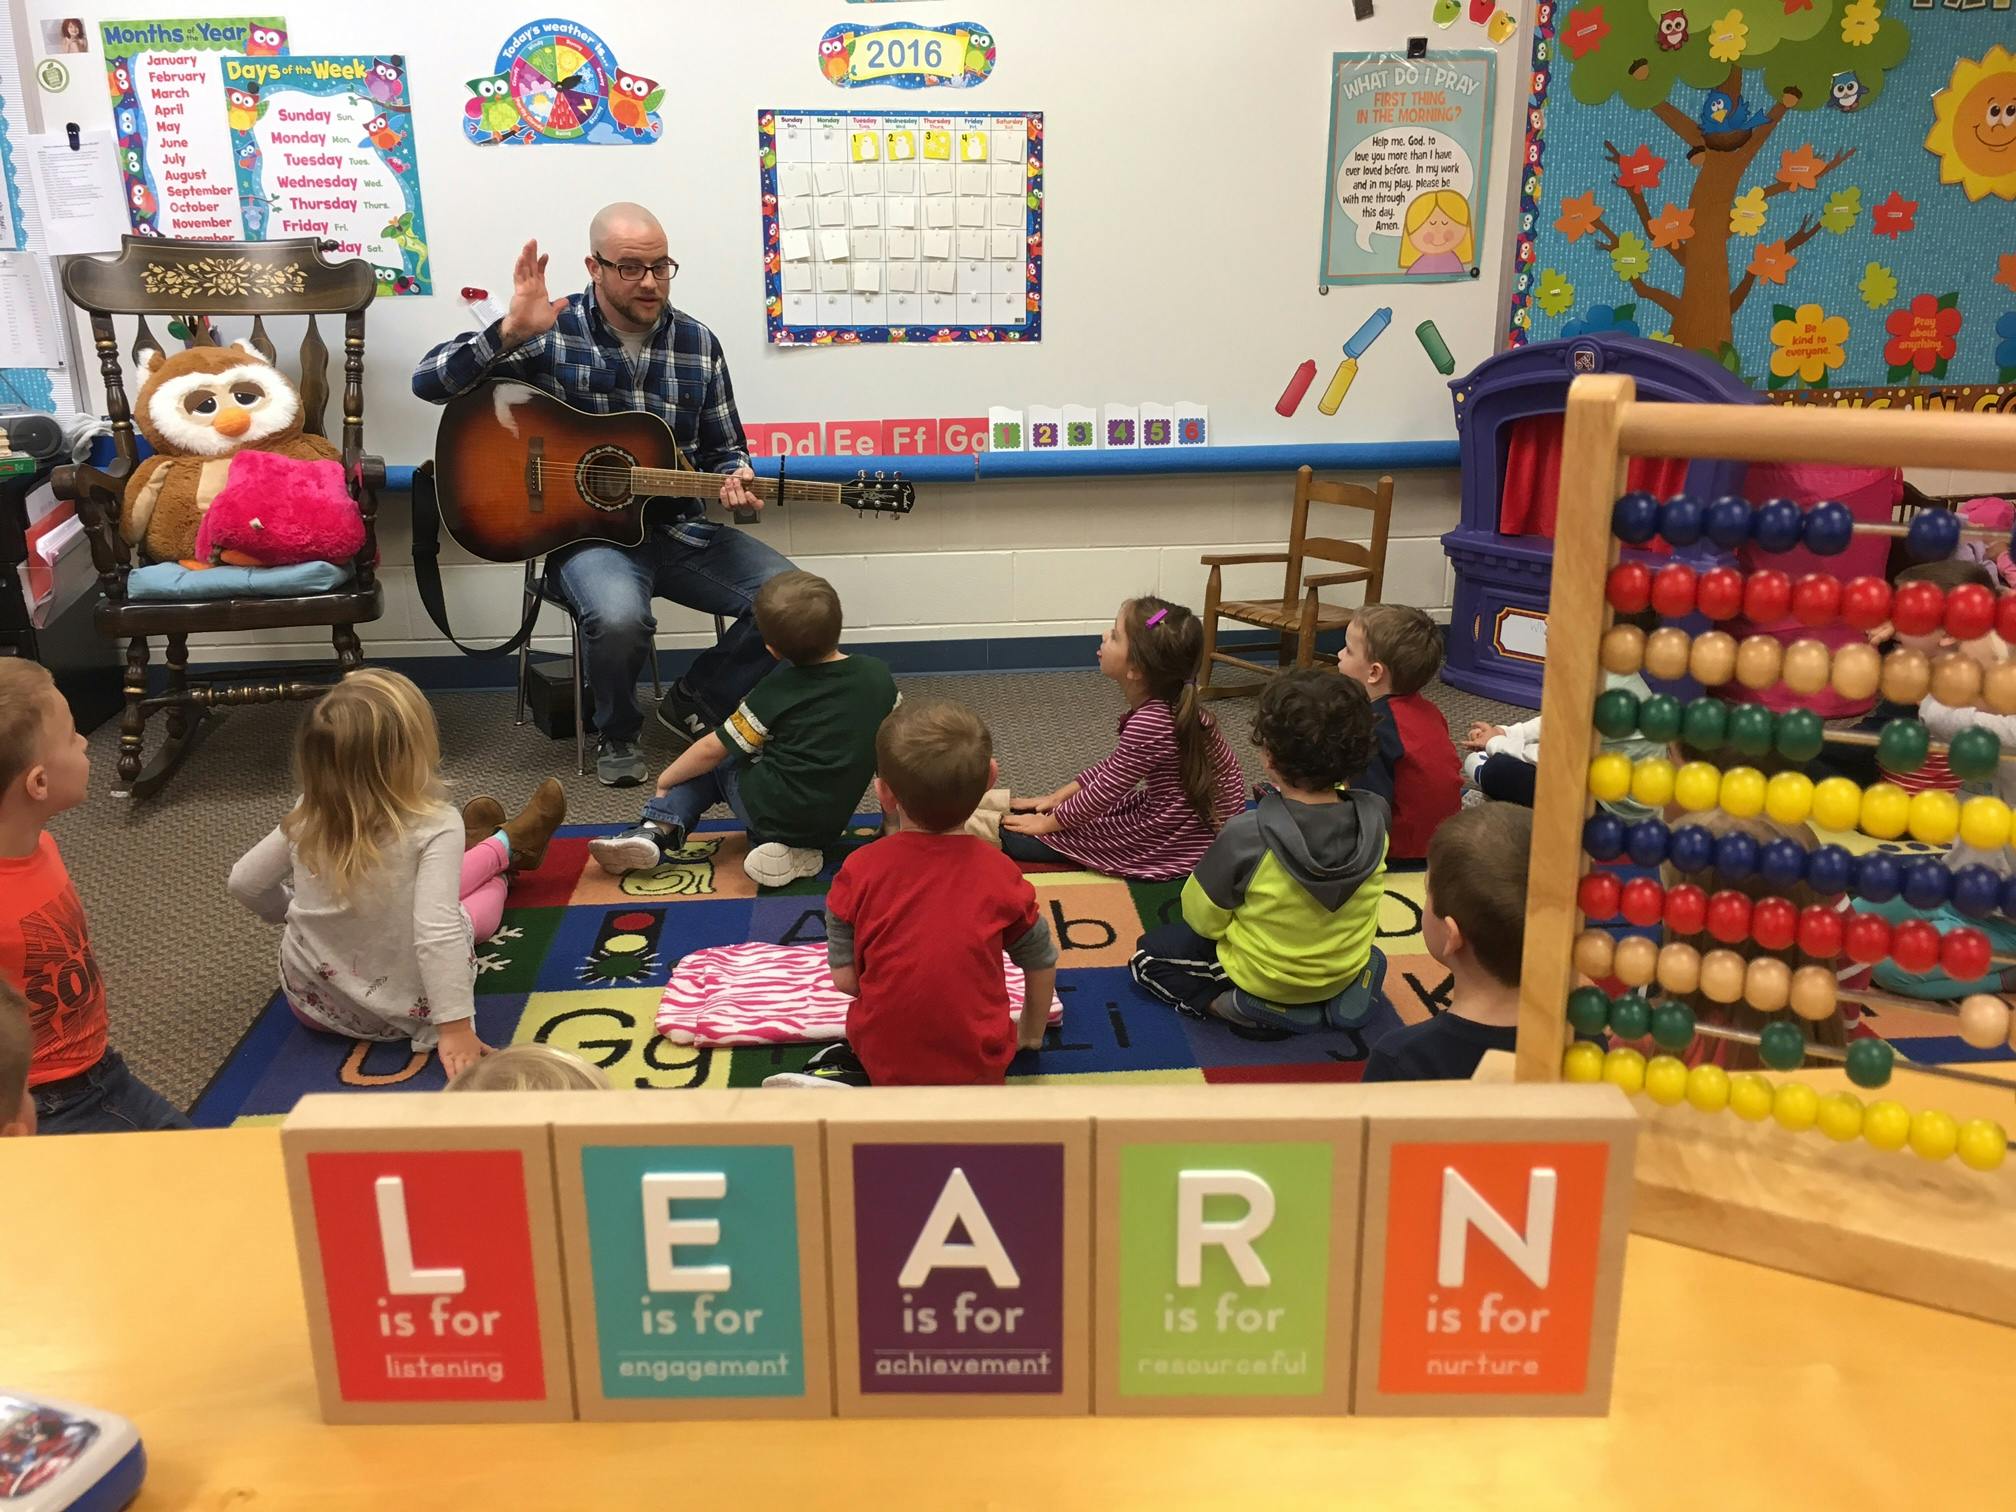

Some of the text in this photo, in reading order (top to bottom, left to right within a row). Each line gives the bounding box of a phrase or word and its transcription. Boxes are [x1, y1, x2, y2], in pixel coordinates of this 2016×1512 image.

[104, 24, 184, 45] Months
[196, 23, 247, 41] Year
[502, 25, 541, 59] Today's
[542, 23, 594, 44] weather
[147, 55, 197, 67] January
[866, 39, 942, 68] 2016
[149, 72, 206, 83] February
[226, 58, 367, 85] Days of the Week
[1344, 67, 1480, 100] WHAT DO I PRAY
[152, 88, 190, 99] March
[1374, 91, 1446, 107] FIRST THING
[155, 104, 184, 117] April
[278, 108, 355, 124] Sunday Sun.
[1357, 106, 1462, 124] IN THE MORNING?
[156, 122, 181, 134] May
[781, 117, 803, 125] Sunday
[885, 117, 917, 125] Wednesday
[160, 138, 188, 148] June
[271, 131, 352, 147] Monday Mon.
[853, 134, 857, 142] 1
[888, 133, 894, 142] 2
[926, 131, 931, 140] 3
[962, 133, 968, 142] 4
[1372, 136, 1389, 149] Help
[1428, 135, 1436, 146] to
[162, 153, 186, 167] July
[284, 153, 371, 169] Tuesday Tues.
[1354, 149, 1453, 164] love you more than I have
[165, 169, 207, 183] August
[1345, 163, 1460, 177] ever loved before. In my work
[277, 175, 357, 191] Wednesday
[1352, 180, 1367, 190] and
[1369, 179, 1377, 189] in
[1378, 180, 1393, 191] my
[1415, 178, 1440, 191] please
[1441, 177, 1451, 188] be
[167, 185, 233, 199] September
[1342, 191, 1406, 206] with me through
[170, 201, 219, 213] October
[289, 197, 390, 213] Thursday Thurs.
[1362, 206, 1396, 220] this day.
[172, 217, 232, 229] November
[282, 219, 328, 235] Friday
[1375, 220, 1400, 231] Amen.
[1804, 324, 1817, 333] Be
[1914, 317, 1936, 327] Pray
[1792, 335, 1827, 345] kind to
[1910, 329, 1937, 338] about
[1785, 349, 1831, 359] everyone.
[1899, 341, 1944, 352] anything.
[1002, 427, 1010, 445] 1
[1039, 426, 1052, 443] 2
[1073, 425, 1086, 442] 3
[1114, 425, 1127, 440] 4
[1151, 423, 1164, 441] 5
[1185, 422, 1199, 440] 6
[771, 431, 814, 456] Dd
[834, 428, 874, 456] Ee
[893, 426, 926, 454] Ff
[375, 1175, 465, 1296] L
[641, 1171, 732, 1293] E
[897, 1166, 1021, 1289] A
[1176, 1169, 1277, 1288] R
[1437, 1166, 1557, 1290] N
[379, 1297, 502, 1337] is for
[641, 1294, 763, 1335] is for
[903, 1291, 1024, 1334] is for
[1164, 1292, 1285, 1333] is for
[1426, 1292, 1551, 1334] is for
[386, 1354, 504, 1382] listening
[618, 1352, 789, 1382] engagement
[875, 1351, 1051, 1376] achievement
[1137, 1349, 1308, 1376] resourceful
[1426, 1352, 1539, 1376] nurture
